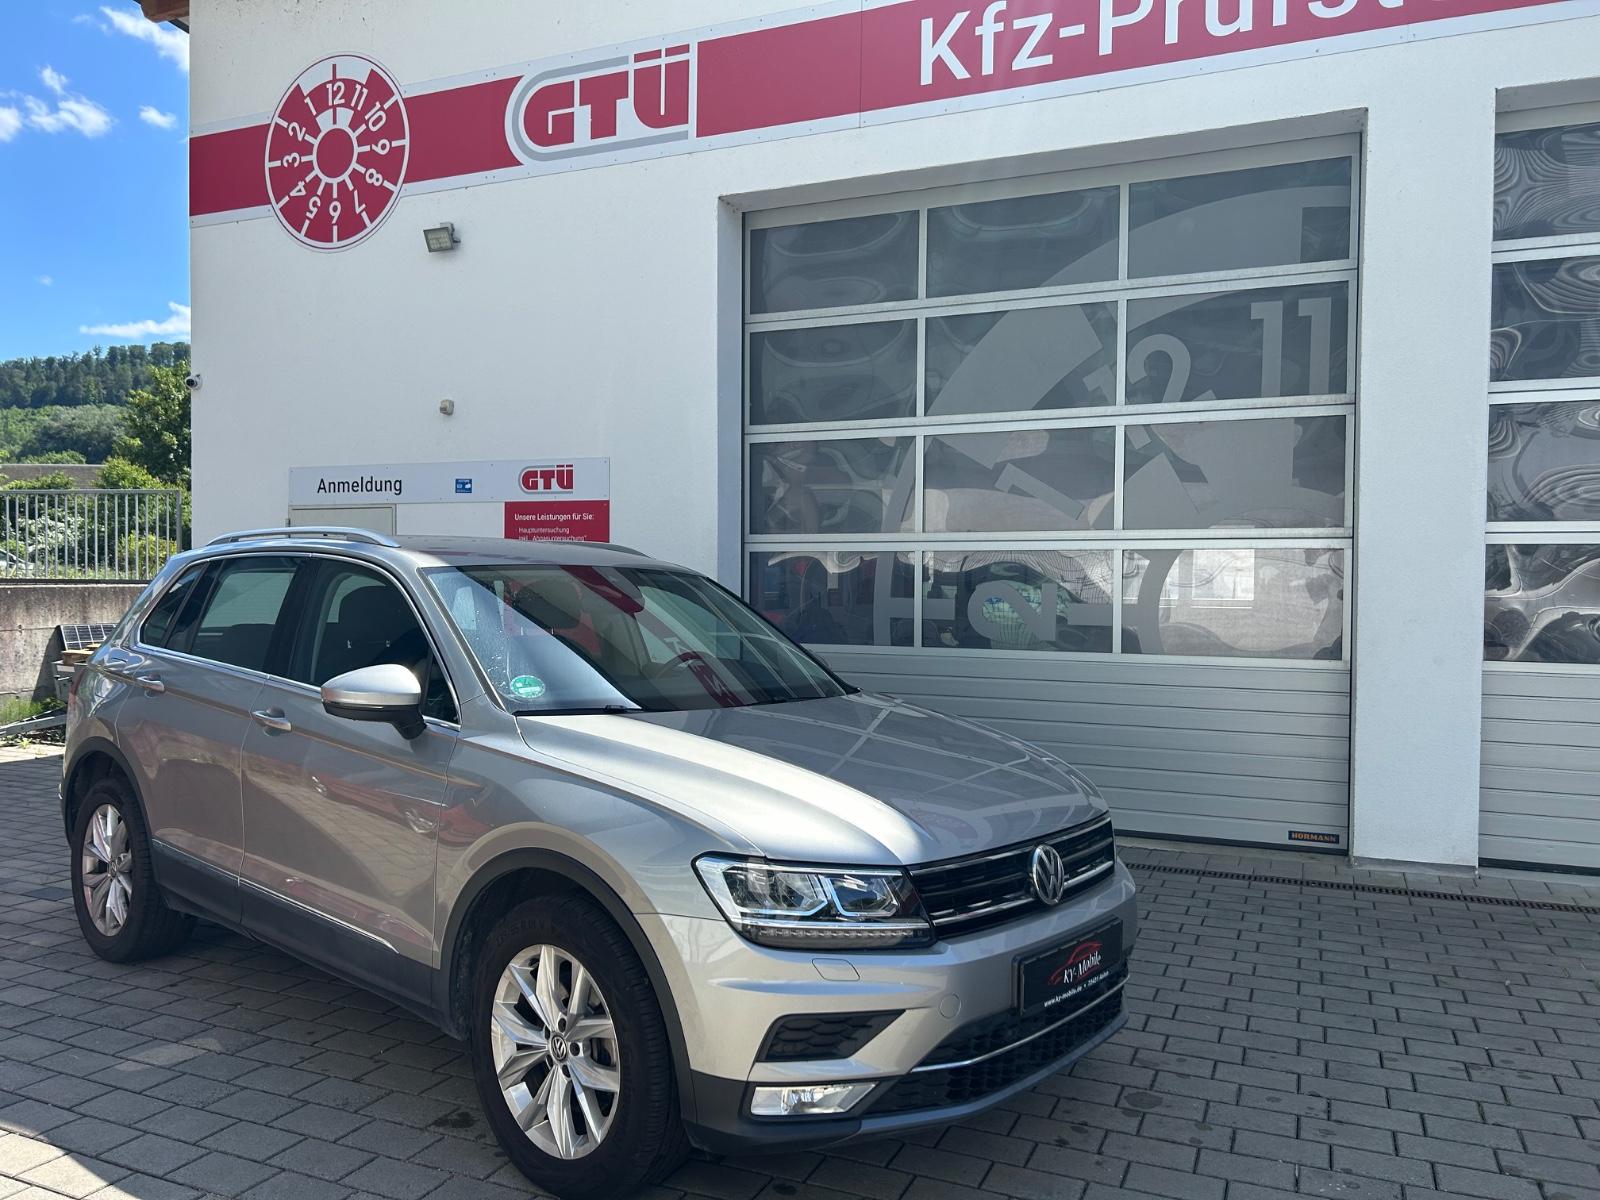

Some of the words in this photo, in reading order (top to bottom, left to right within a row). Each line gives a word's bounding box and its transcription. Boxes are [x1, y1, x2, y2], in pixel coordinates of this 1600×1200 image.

[326, 81, 345, 105] 12
[351, 83, 369, 111] 11
[523, 43, 690, 147] GTÜ
[304, 96, 317, 116] 1
[364, 101, 387, 132] 10
[287, 121, 306, 141] 2
[371, 138, 390, 155] 9
[282, 152, 300, 168] 3
[365, 168, 383, 186] 8
[289, 180, 307, 197] 4
[306, 196, 321, 220] 5
[329, 200, 342, 225] 6
[353, 189, 366, 215] 7
[317, 475, 402, 496] Anmeldung
[521, 464, 574, 490] GTÜ
[514, 513, 536, 521] Unsere
[537, 513, 571, 522] Leistungen
[572, 512, 581, 521] für
